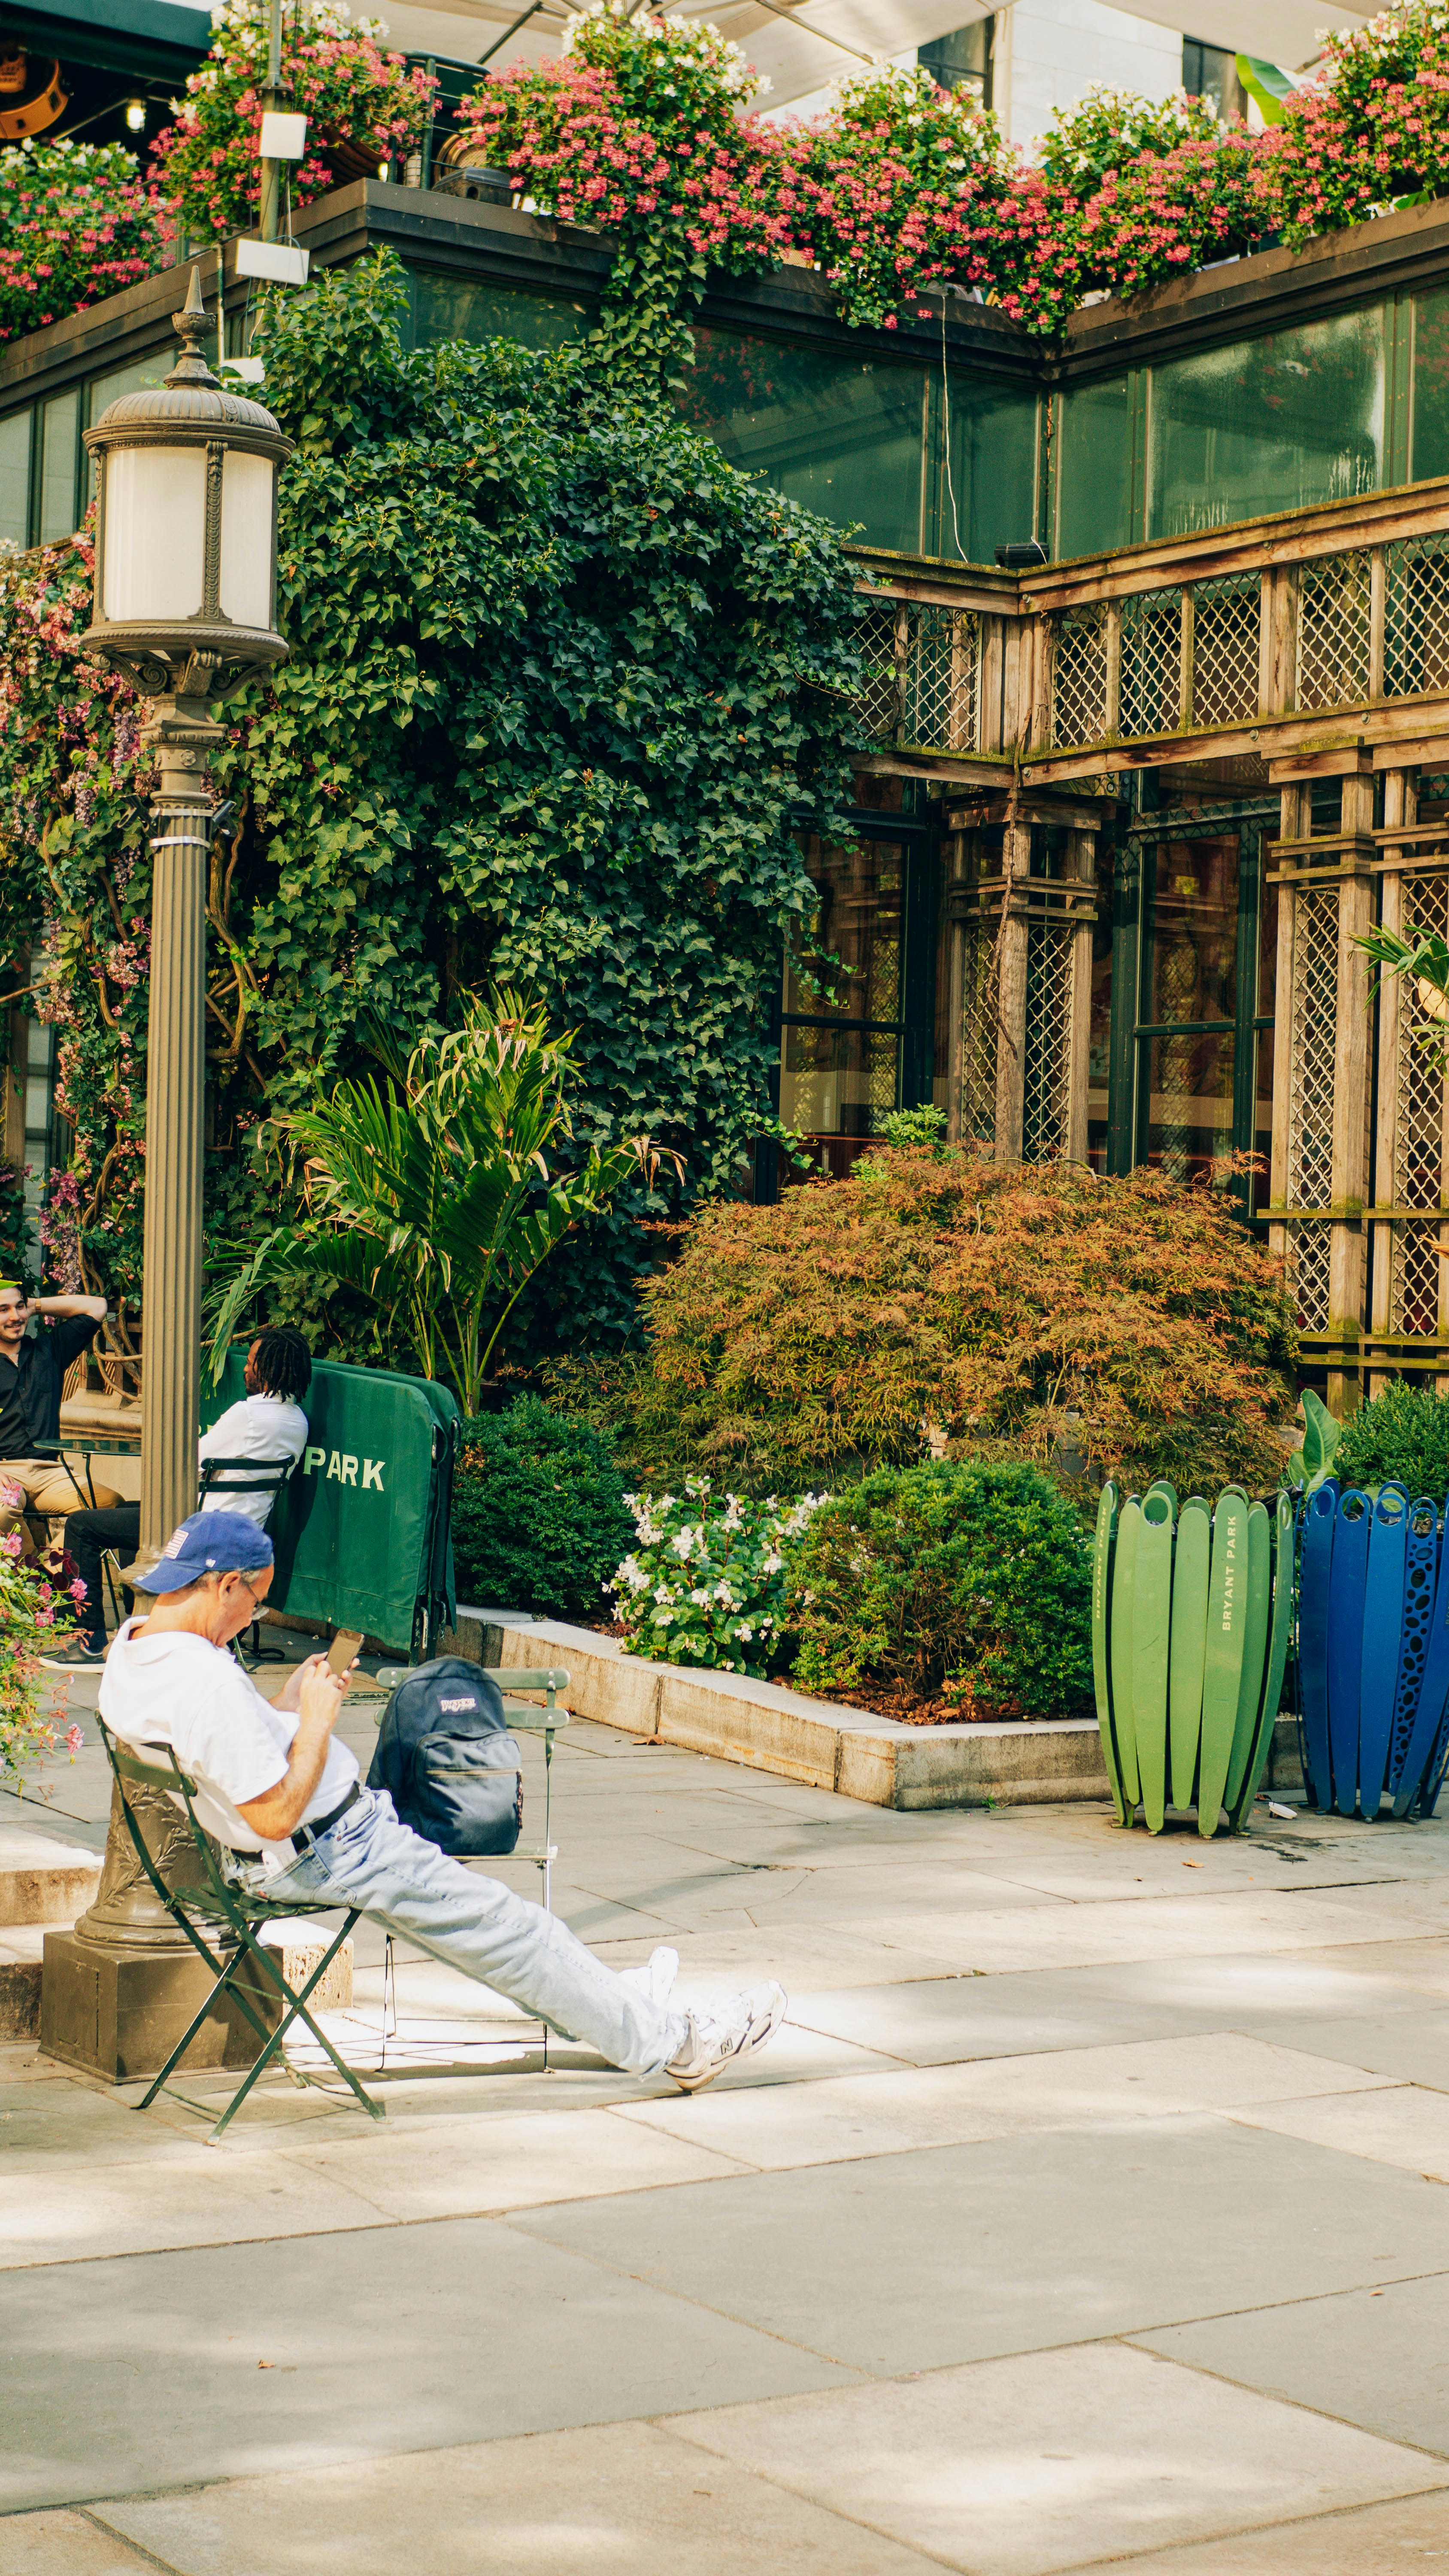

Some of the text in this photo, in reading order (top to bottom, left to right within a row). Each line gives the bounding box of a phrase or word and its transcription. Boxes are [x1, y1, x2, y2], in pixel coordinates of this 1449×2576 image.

[303, 1446, 386, 1492] PARK
[1222, 1516, 1236, 1631] BRYANT PARK
[721, 2037, 733, 2055] N
